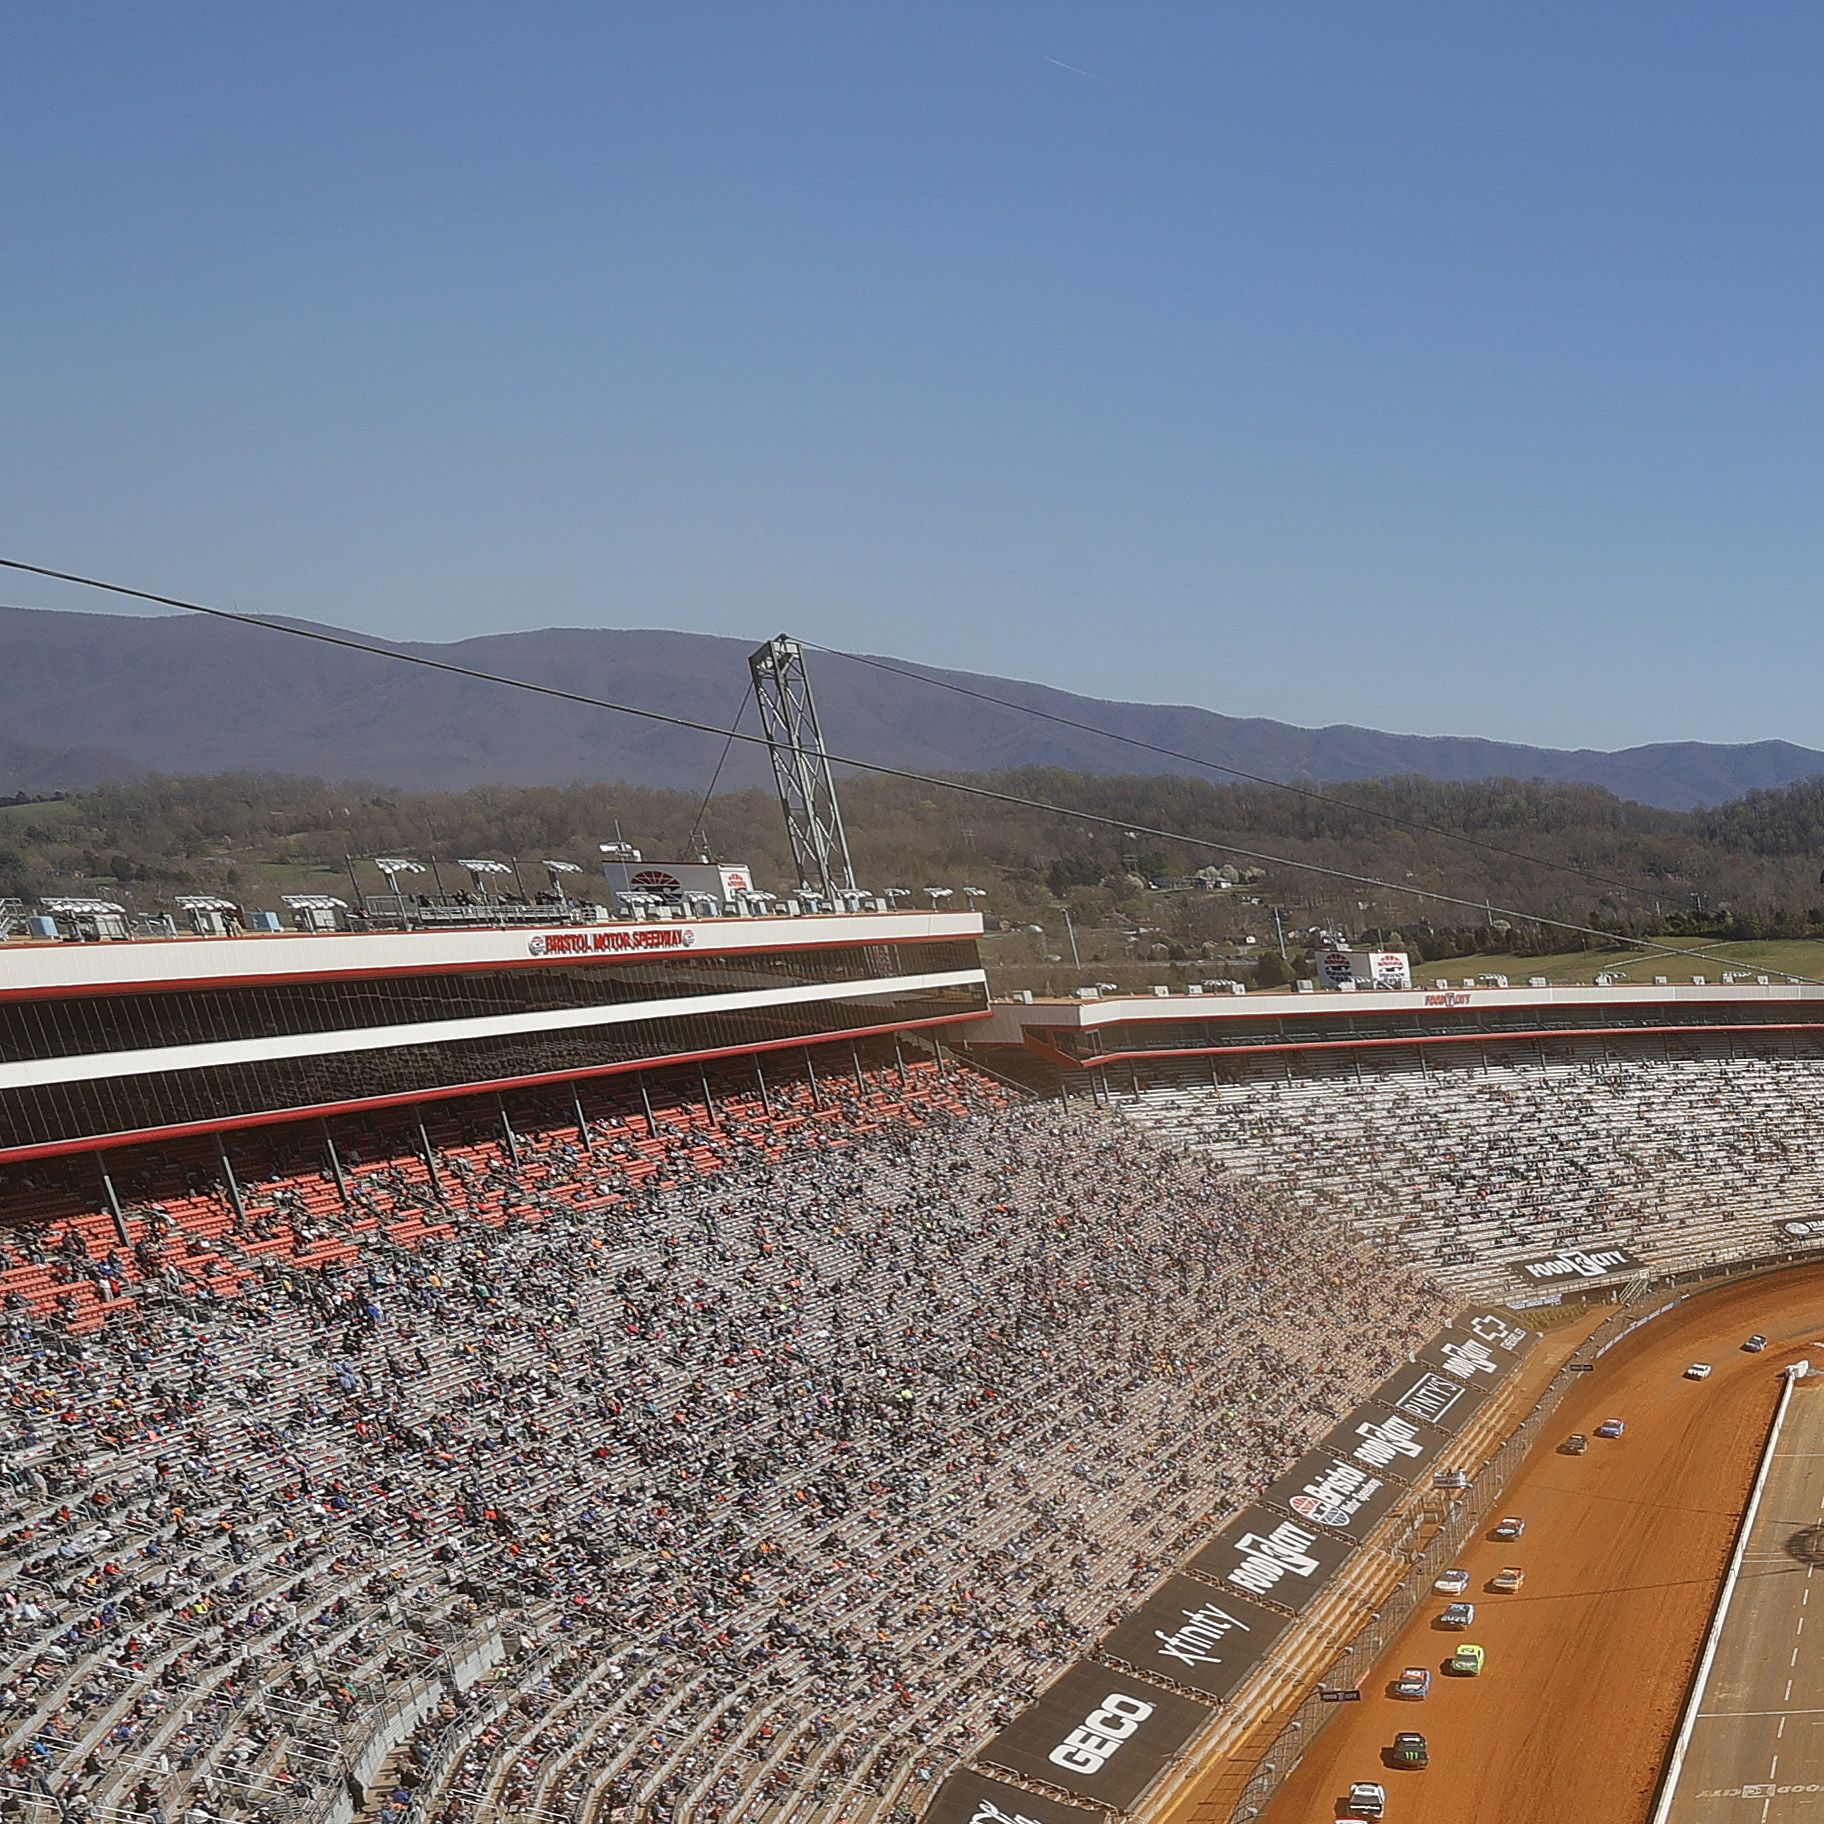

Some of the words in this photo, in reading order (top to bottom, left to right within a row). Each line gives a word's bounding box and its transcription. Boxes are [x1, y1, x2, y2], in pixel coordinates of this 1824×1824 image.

[545, 933, 591, 951] BRISTOL
[594, 931, 631, 949] MOTOR
[633, 929, 683, 948] SPEEDWAY
[1525, 1259, 1572, 1278] FOOD
[1597, 1251, 1628, 1268] CITY
[1404, 1376, 1457, 1417] PINTY'S
[1353, 1436, 1397, 1468] FOOD
[1303, 1459, 1368, 1507] Bristol
[1227, 1553, 1285, 1595] FOOD
[1263, 1521, 1317, 1556] CITY
[1155, 1602, 1250, 1666] xfinity
[1049, 1693, 1153, 1775] GEICO
